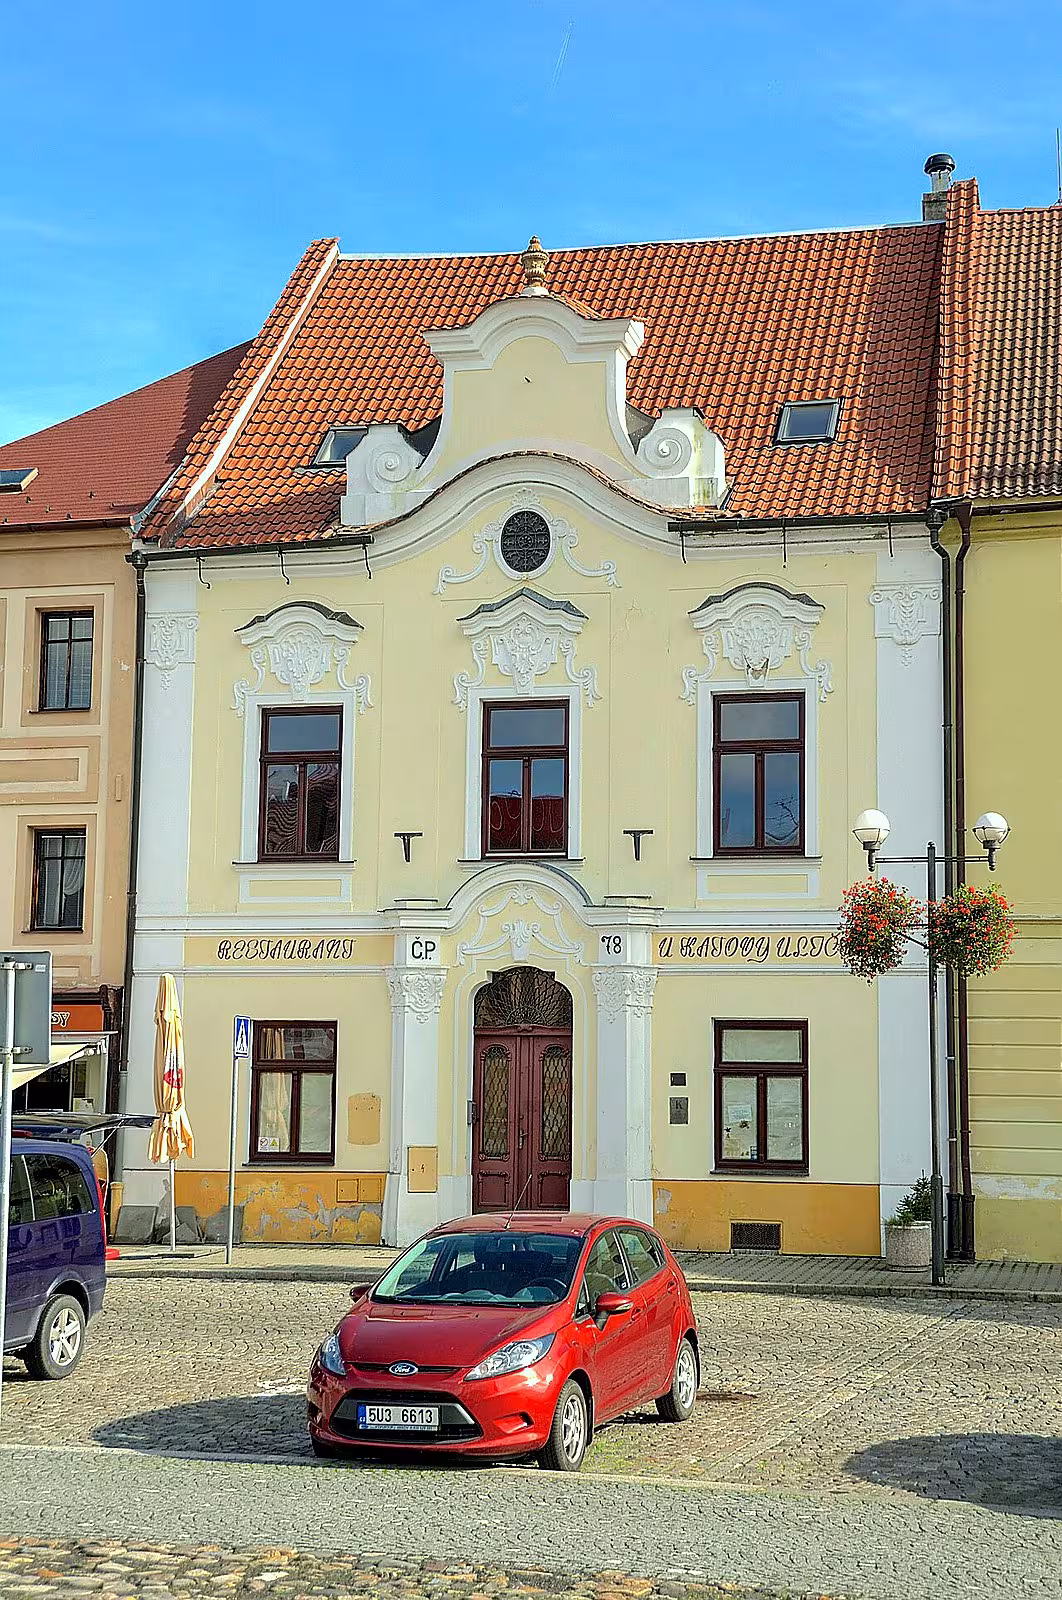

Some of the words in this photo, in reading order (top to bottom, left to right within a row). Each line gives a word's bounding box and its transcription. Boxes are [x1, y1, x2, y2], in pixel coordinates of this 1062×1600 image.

[217, 939, 356, 960] RESTAURANT
[600, 935, 622, 955] 78
[658, 936, 673, 957] U
[368, 1407, 392, 1423] 5U3
[401, 1408, 433, 1424] 6613
